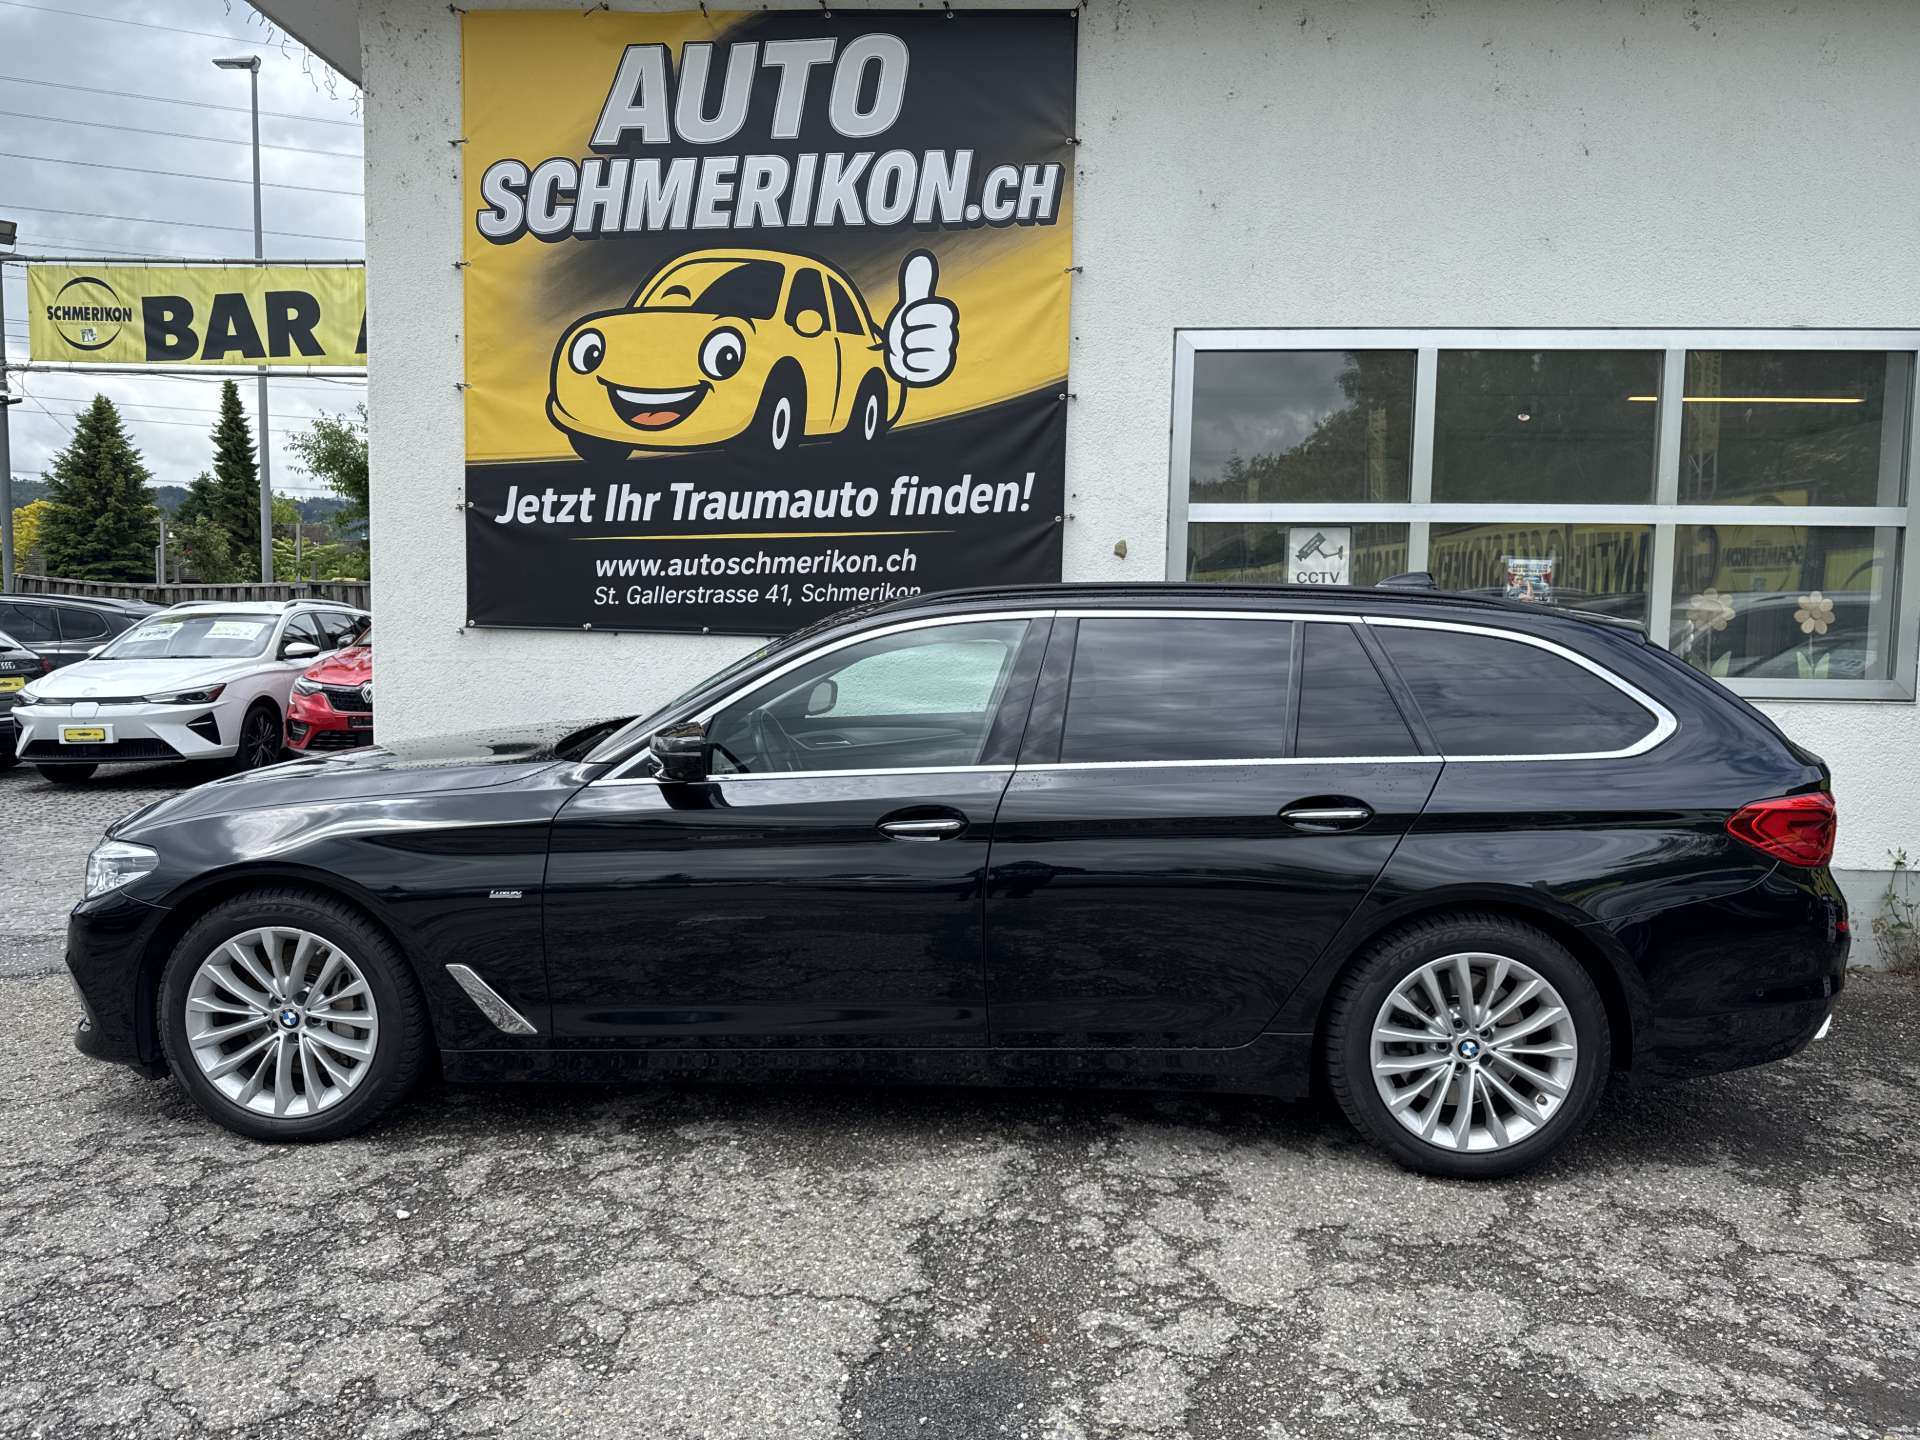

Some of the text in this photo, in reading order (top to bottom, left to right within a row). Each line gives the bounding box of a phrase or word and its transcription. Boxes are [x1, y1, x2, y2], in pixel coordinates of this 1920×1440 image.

[591, 33, 910, 149] AUTO
[476, 149, 1064, 240] SCHMERIKON.CH
[47, 306, 132, 322] SCHMERIKON
[142, 290, 327, 361] BAR
[494, 472, 1036, 524] Jetzt Ihr Traumauto finden!
[595, 548, 917, 577] www.autoschmerikon.ch
[1296, 571, 1340, 584] CCTV
[594, 582, 921, 607] St. Gallerstrasse 41, Schmerikon
